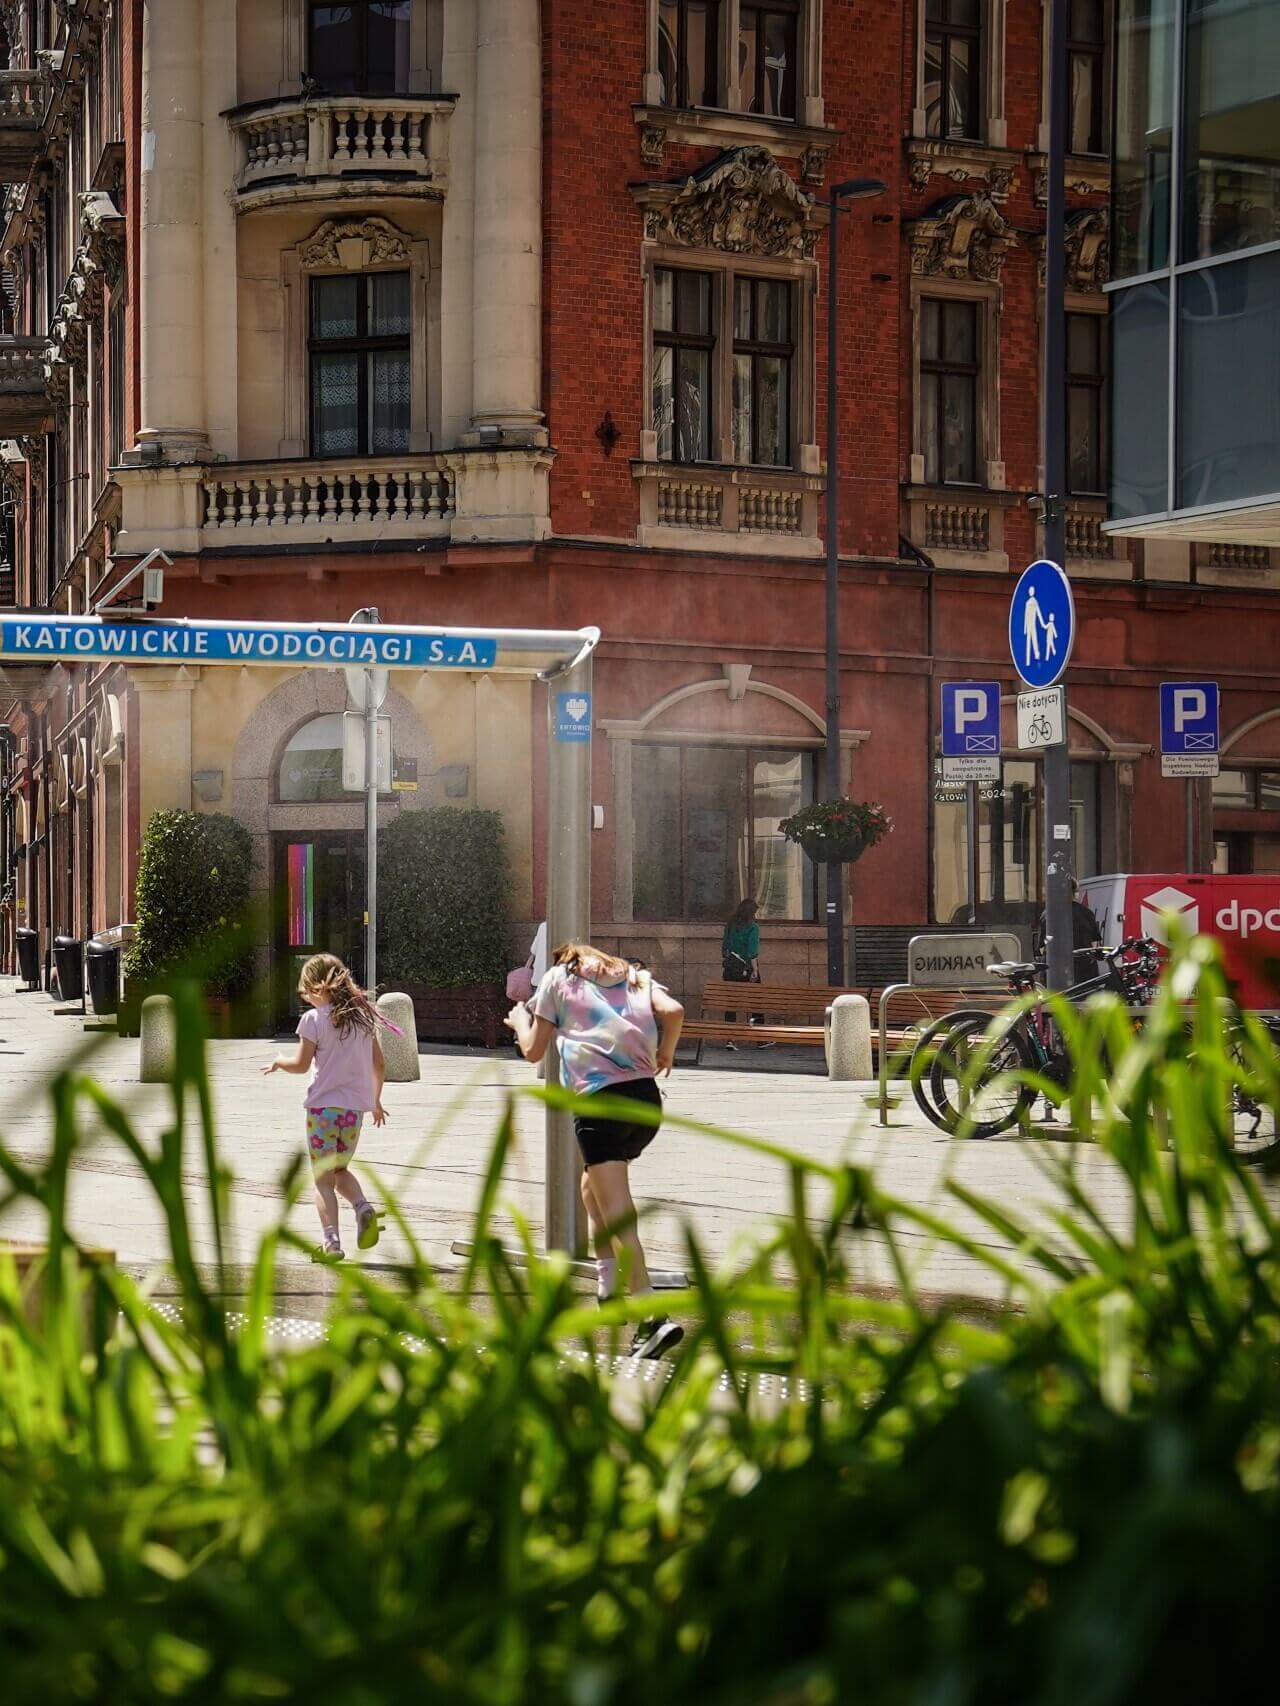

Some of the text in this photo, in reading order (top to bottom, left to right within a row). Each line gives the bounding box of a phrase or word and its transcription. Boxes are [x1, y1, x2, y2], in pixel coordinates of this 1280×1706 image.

[15, 626, 489, 664] KATOWICKIE WODOCIĄGI S.A.
[954, 689, 988, 734] P
[1018, 694, 1059, 710] Nie dotyczy
[1174, 689, 1207, 732] P
[980, 789, 1006, 799] 2024
